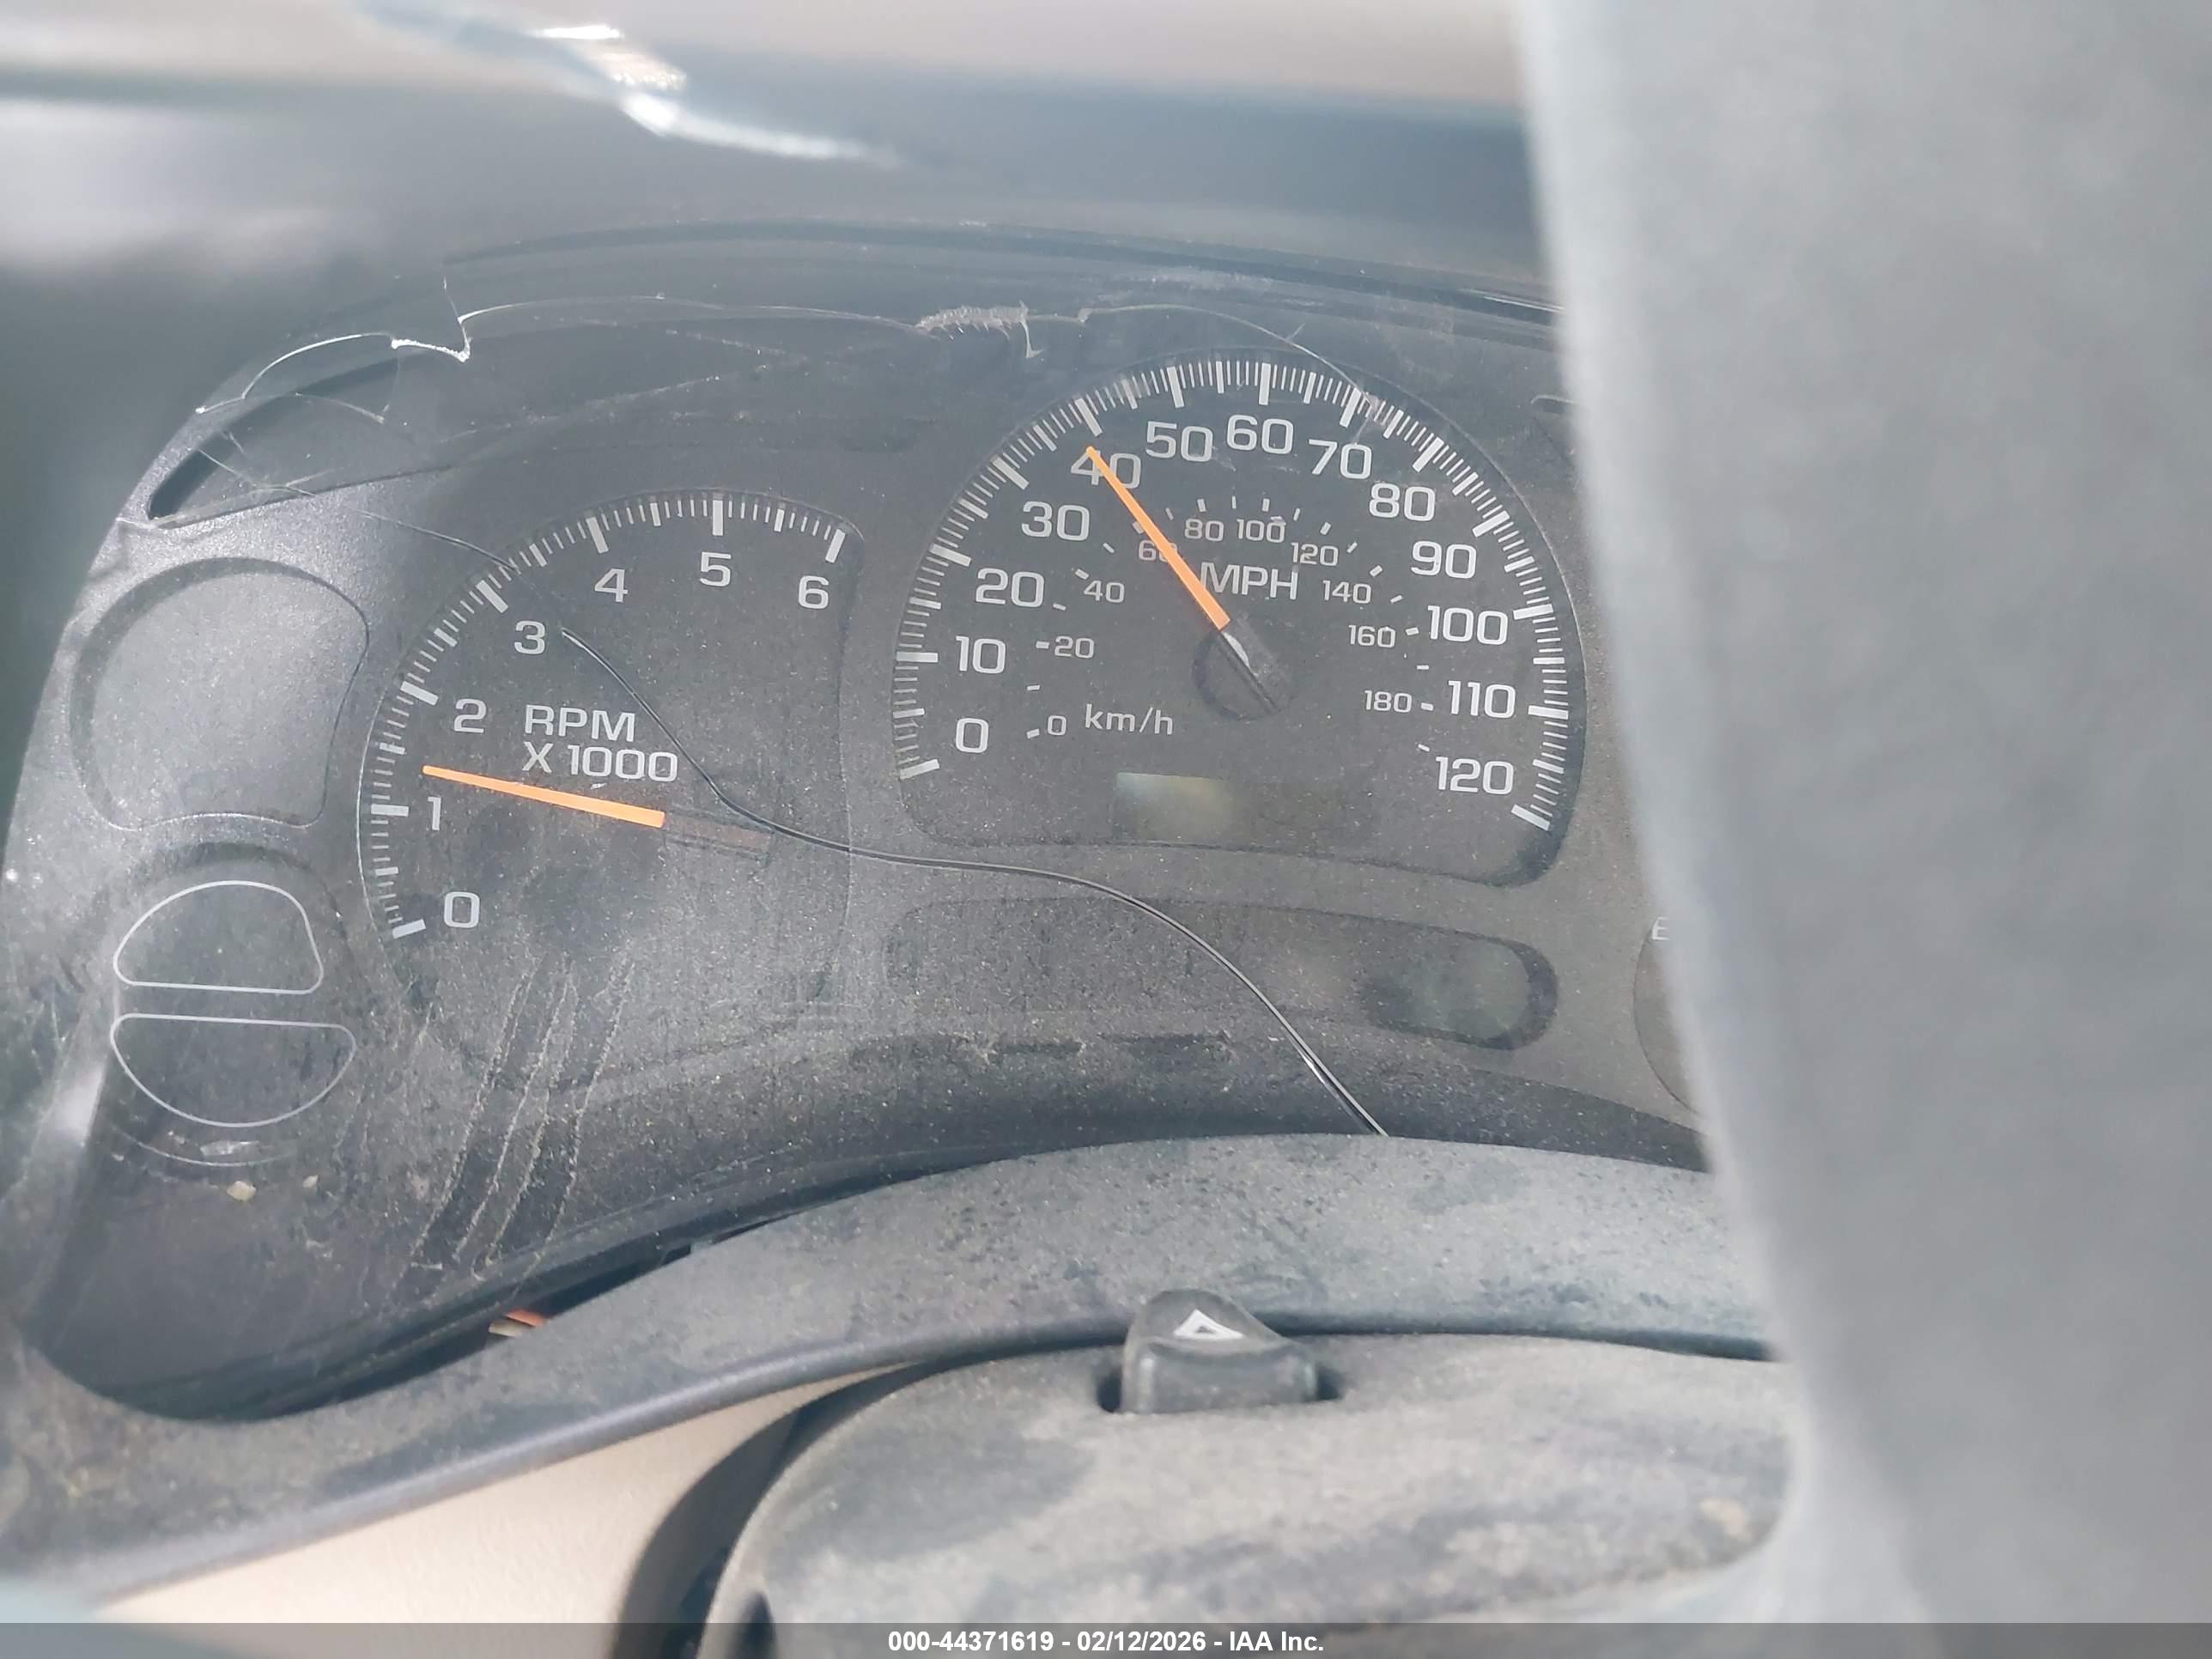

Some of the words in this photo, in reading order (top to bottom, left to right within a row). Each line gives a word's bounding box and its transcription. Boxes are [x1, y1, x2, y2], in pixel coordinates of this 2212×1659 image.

[1146, 420, 1213, 462] 50
[1226, 414, 1294, 454] 60
[1071, 450, 1141, 489] 40
[1308, 439, 1372, 480] 70
[1369, 483, 1436, 522] 80
[1021, 501, 1090, 542] 30
[1184, 518, 1224, 542] 80
[1237, 519, 1285, 544] 100
[700, 551, 732, 587] 5
[1139, 539, 1178, 563] 6
[1291, 542, 1339, 567] 120
[1410, 541, 1477, 579] 90
[593, 568, 629, 602] 4
[798, 575, 830, 610] 6
[975, 568, 1044, 608] 20
[1084, 580, 1125, 604] 40
[1200, 562, 1298, 600] MPH
[1322, 580, 1371, 605] 140
[514, 620, 546, 655] 3
[1348, 624, 1395, 648] 160
[1427, 605, 1508, 646] 100
[956, 635, 1006, 674] 10
[1054, 635, 1095, 659] 20
[453, 698, 487, 734] 2
[1364, 690, 1413, 714] 180
[1448, 680, 1516, 719] 110
[524, 704, 635, 742] RPM
[955, 717, 989, 754] 0
[1047, 714, 1067, 736] 0
[1085, 703, 1174, 736] km/h
[521, 741, 553, 773] X
[567, 744, 678, 782] 1000
[1435, 757, 1514, 795] 120
[427, 796, 442, 831] 1
[443, 891, 481, 929] 0
